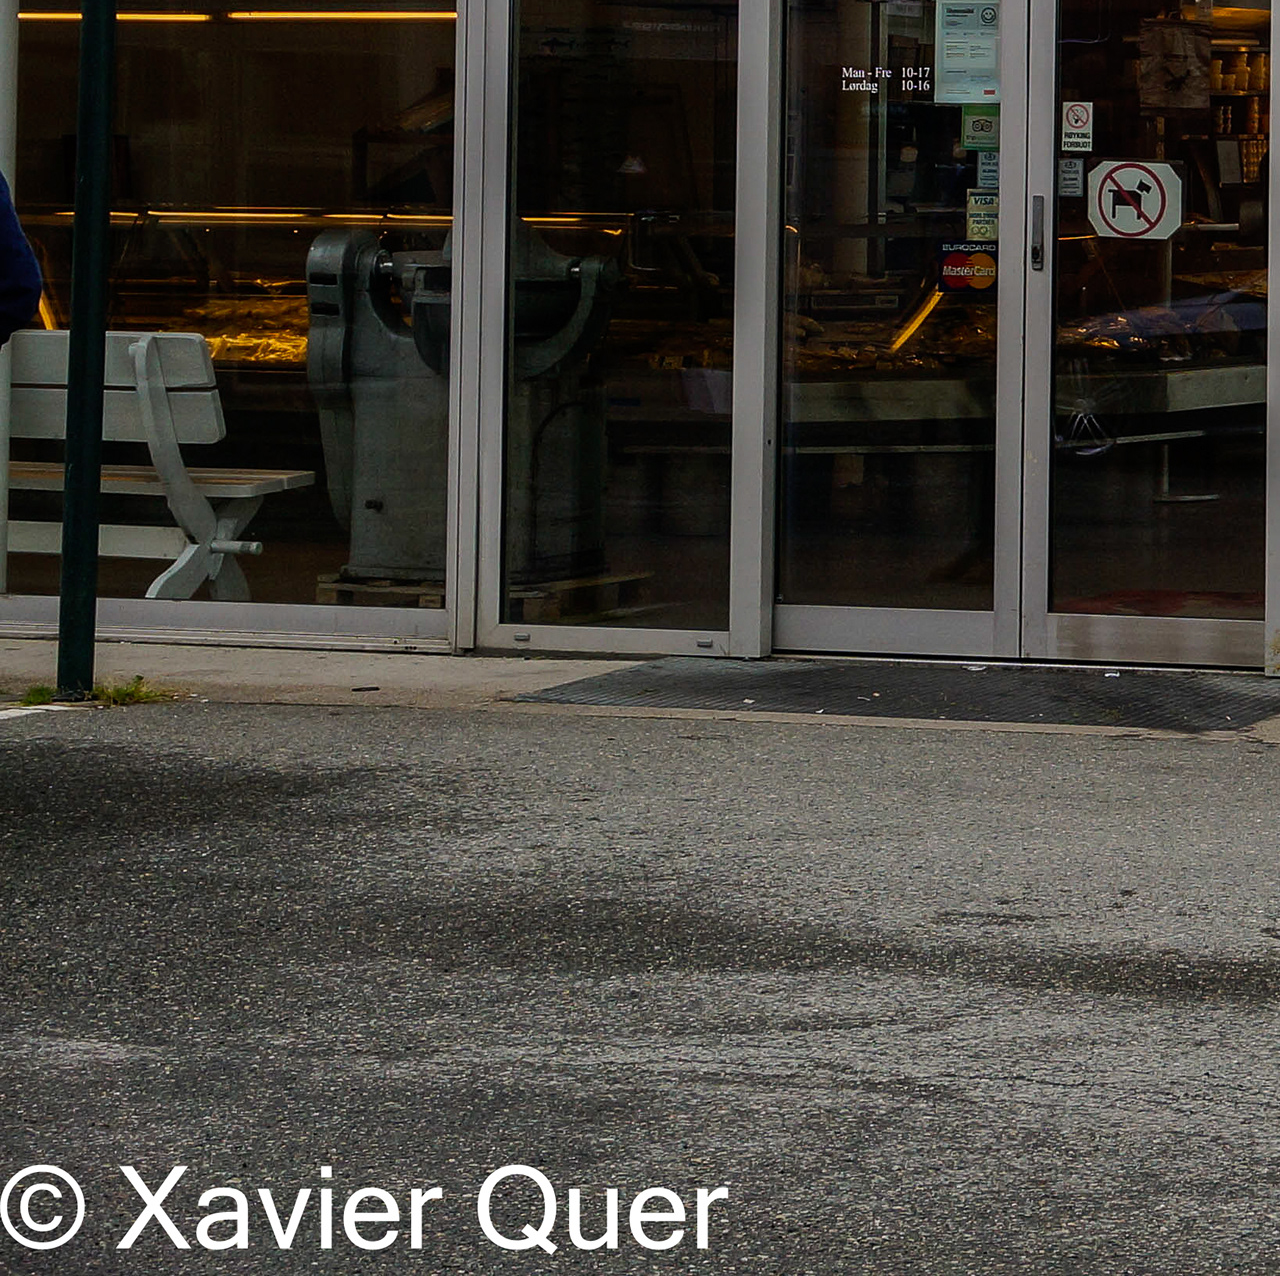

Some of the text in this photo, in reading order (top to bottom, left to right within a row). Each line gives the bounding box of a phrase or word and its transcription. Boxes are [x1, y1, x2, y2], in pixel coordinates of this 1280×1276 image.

[842, 67, 865, 78] Man
[875, 67, 892, 78] Fre
[902, 67, 930, 78] 10-17
[842, 80, 930, 94] Lørdag 10-16
[973, 197, 995, 205] VISA
[942, 266, 996, 276] MasterCard
